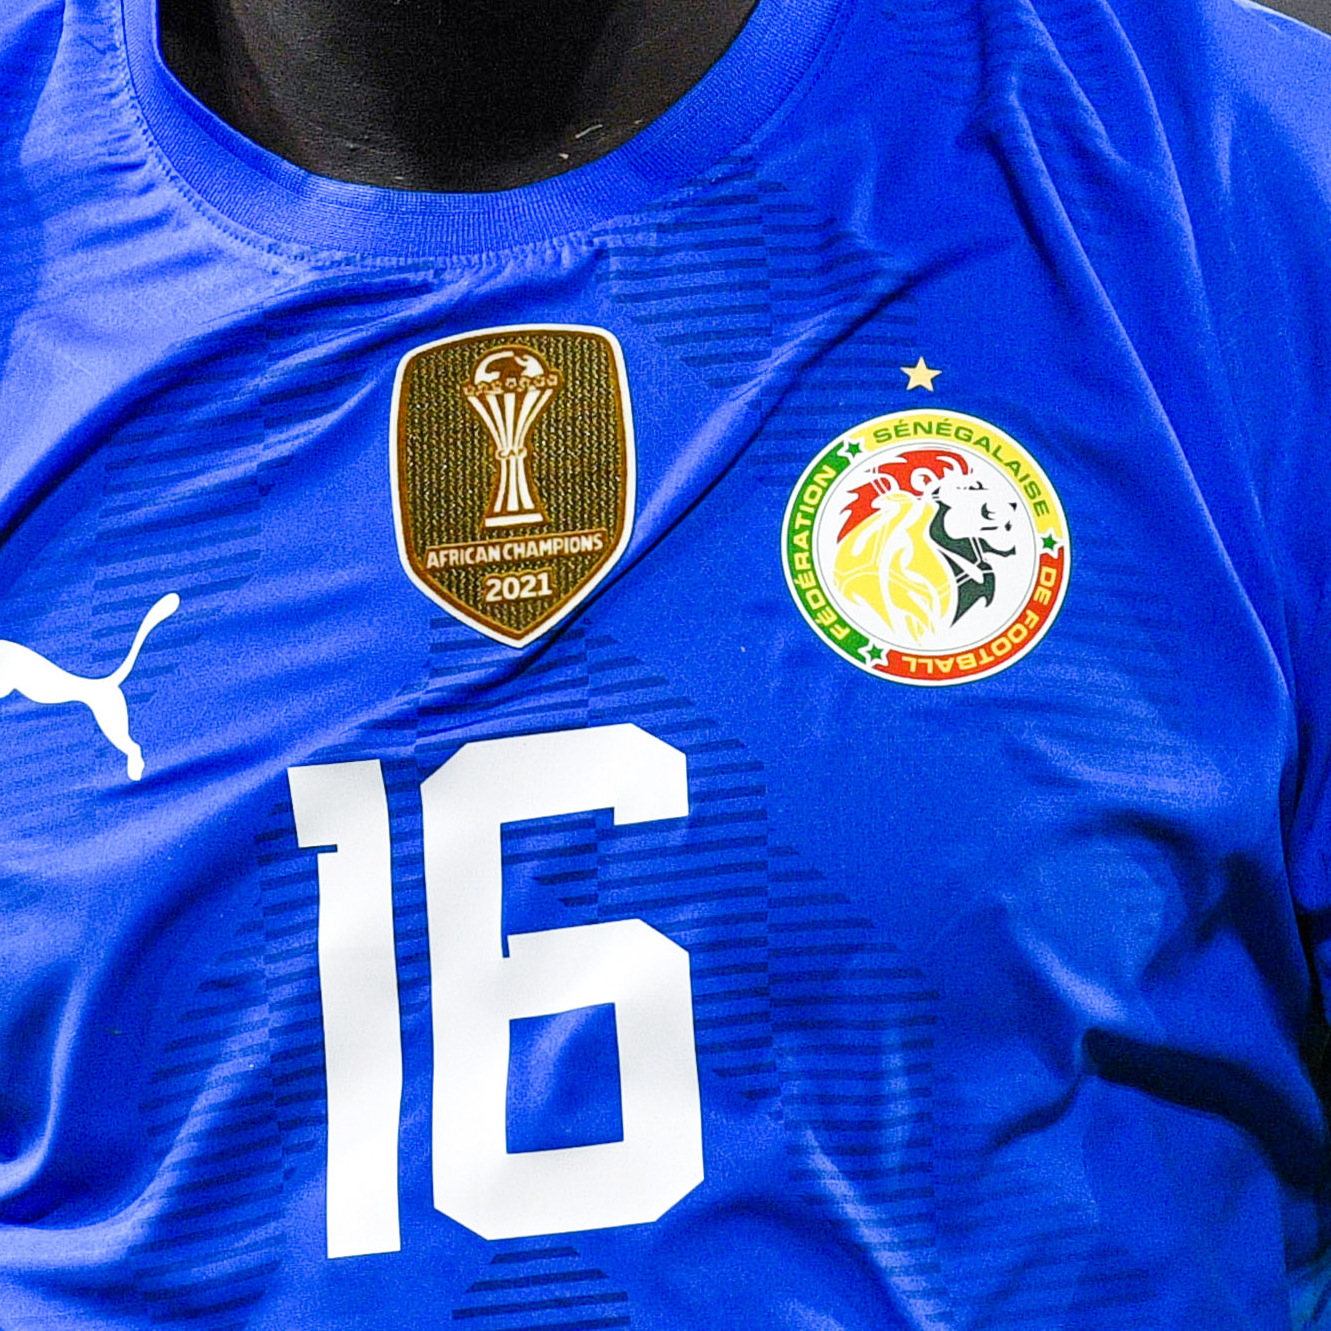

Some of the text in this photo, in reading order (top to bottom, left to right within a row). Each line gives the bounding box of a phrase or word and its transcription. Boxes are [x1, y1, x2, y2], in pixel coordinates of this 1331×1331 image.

[873, 418, 1050, 517] SÉNÉGALAISE
[426, 532, 604, 569] AFRICAN CHAMPIONS
[485, 572, 552, 602] 2021
[793, 464, 850, 640] FÉDÉRATION
[901, 566, 1057, 674] DE FOOTBALL
[287, 722, 705, 1260] 16
